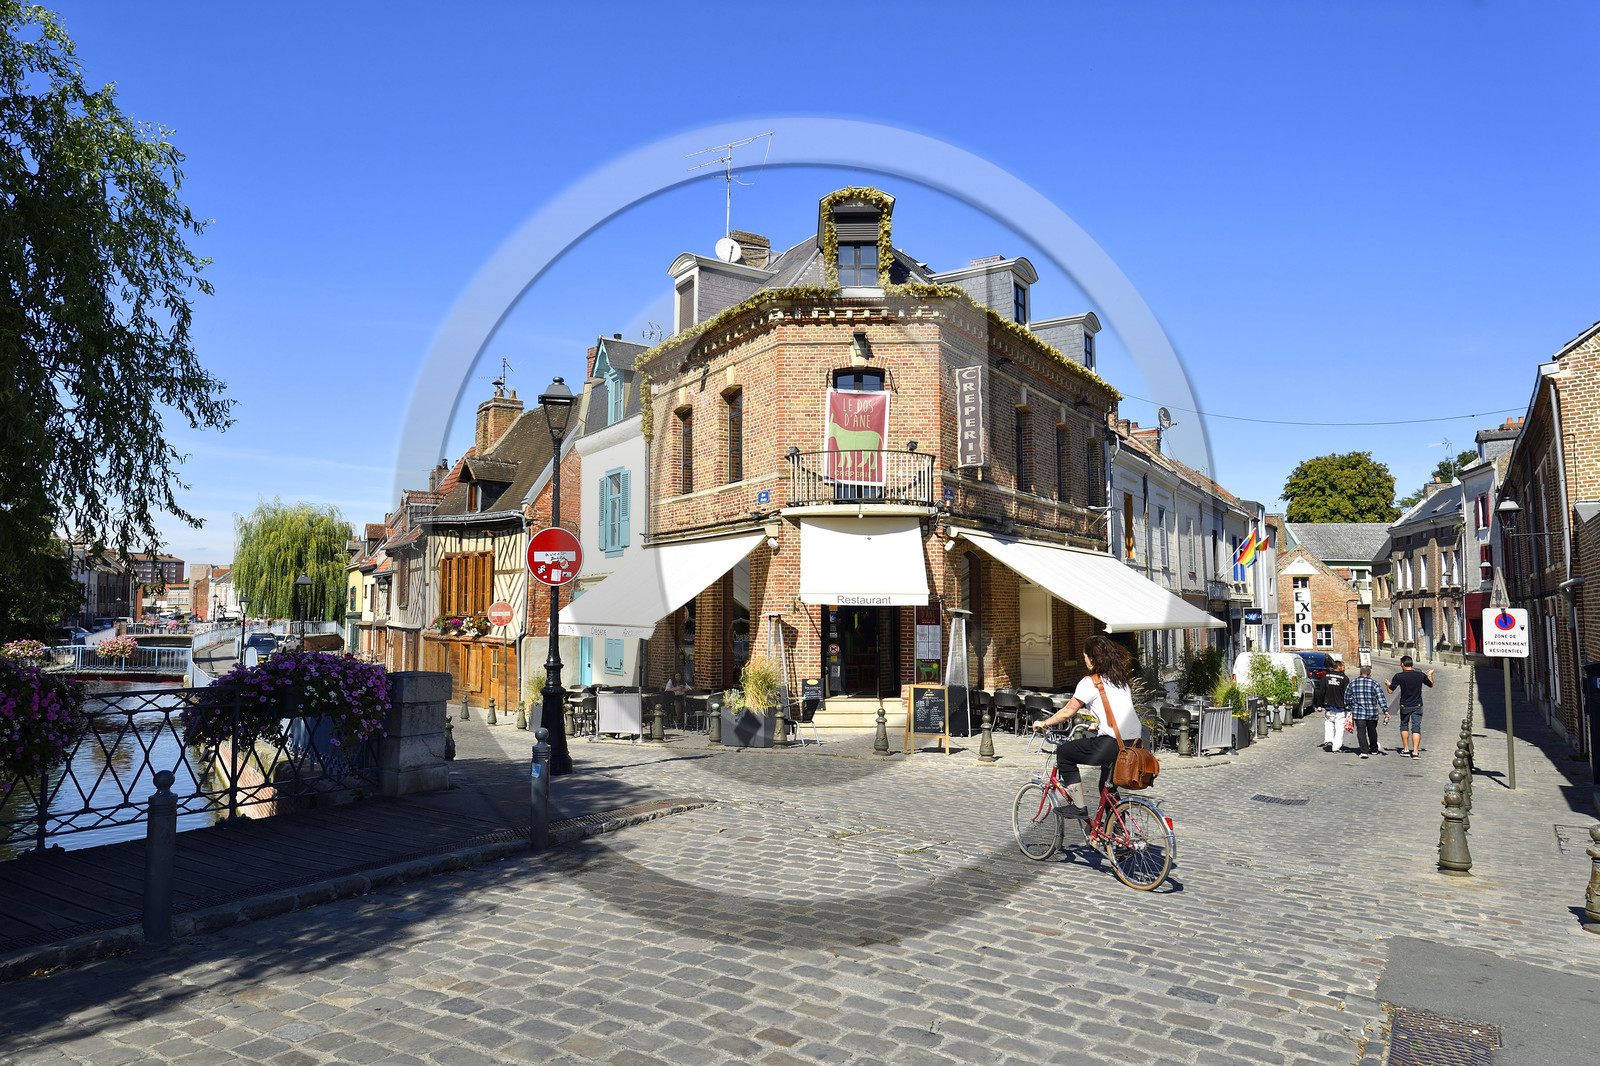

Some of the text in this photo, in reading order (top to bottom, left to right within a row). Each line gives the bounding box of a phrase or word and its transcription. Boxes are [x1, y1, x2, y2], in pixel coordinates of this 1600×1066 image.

[843, 398, 874, 414] LE DOS
[961, 369, 977, 464] CREPERIE
[836, 595, 892, 605] Restaurant
[1294, 591, 1311, 634] EXPO
